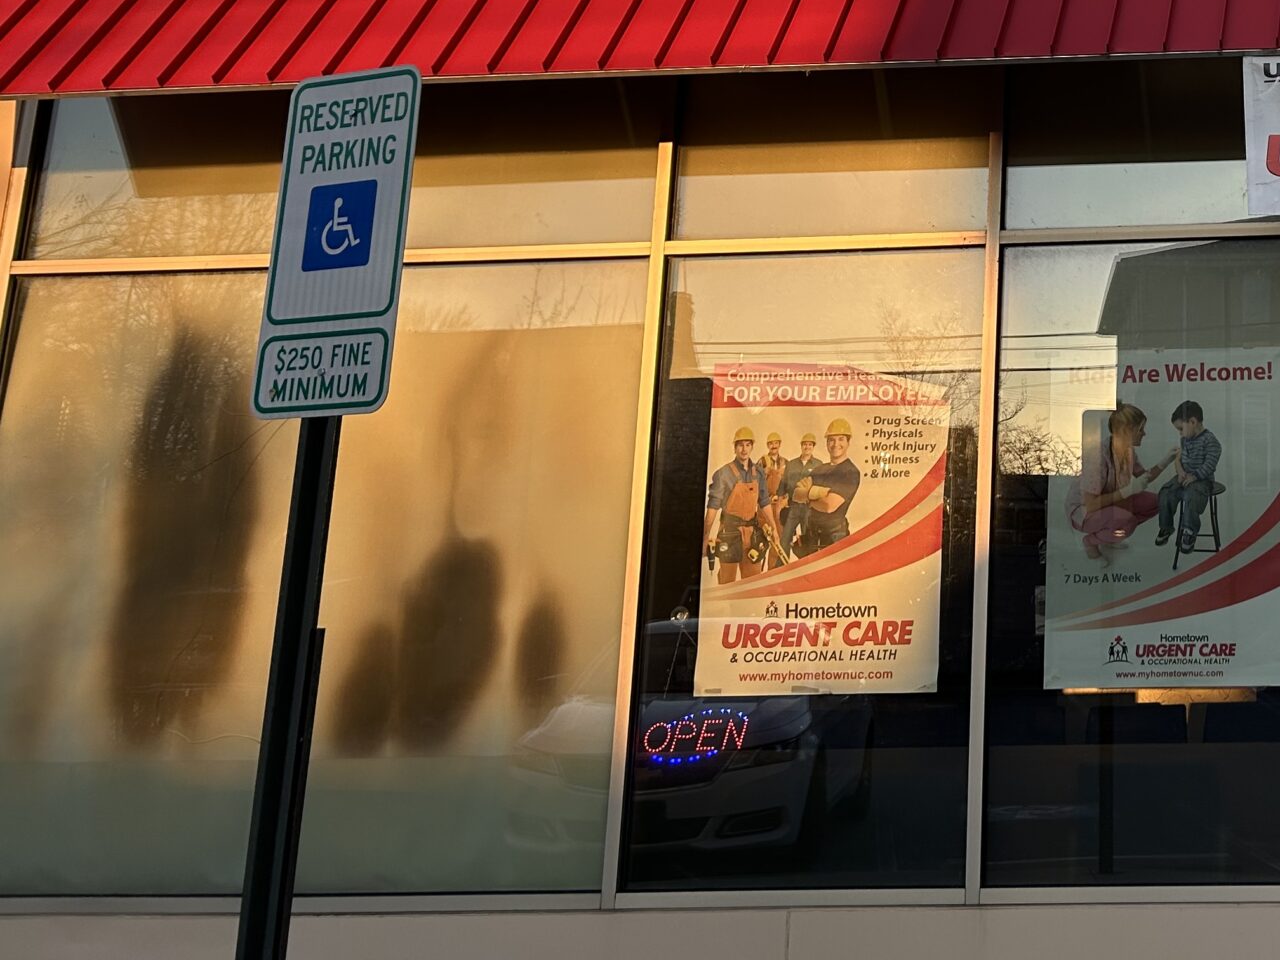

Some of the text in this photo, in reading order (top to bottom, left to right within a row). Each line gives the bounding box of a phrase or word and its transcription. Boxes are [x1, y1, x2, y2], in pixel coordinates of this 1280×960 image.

[298, 90, 410, 134] RESERVED
[299, 133, 398, 175] PARKING
[274, 341, 373, 377] $250 FINE
[727, 368, 844, 385] Comprehensive
[1121, 365, 1160, 384] Are
[1164, 361, 1274, 383] Welcome!
[270, 372, 370, 404] MINIMUM
[723, 385, 761, 403] FOR
[765, 384, 821, 402] YOUR
[873, 415, 901, 428] Drug
[871, 427, 924, 440] Physicals
[870, 440, 937, 453] Work Injury
[870, 454, 920, 465] Wellness
[870, 468, 911, 479] & More
[1064, 572, 1143, 586] 7 Days A Week
[785, 601, 878, 619] Hometown
[720, 619, 915, 650] URGENT CARE
[1159, 633, 1209, 643] Hometown
[729, 648, 898, 664] & OCCUPATIONAL HEALTH
[1135, 643, 1237, 658] URGENT CARE
[1147, 658, 1202, 666] OCCUPATIONAL
[1203, 657, 1230, 666] HEALTH
[738, 669, 894, 684] www.myhometownuc.com
[1115, 669, 1224, 680] www.myhometownuc.com
[643, 718, 750, 753] OPEN
